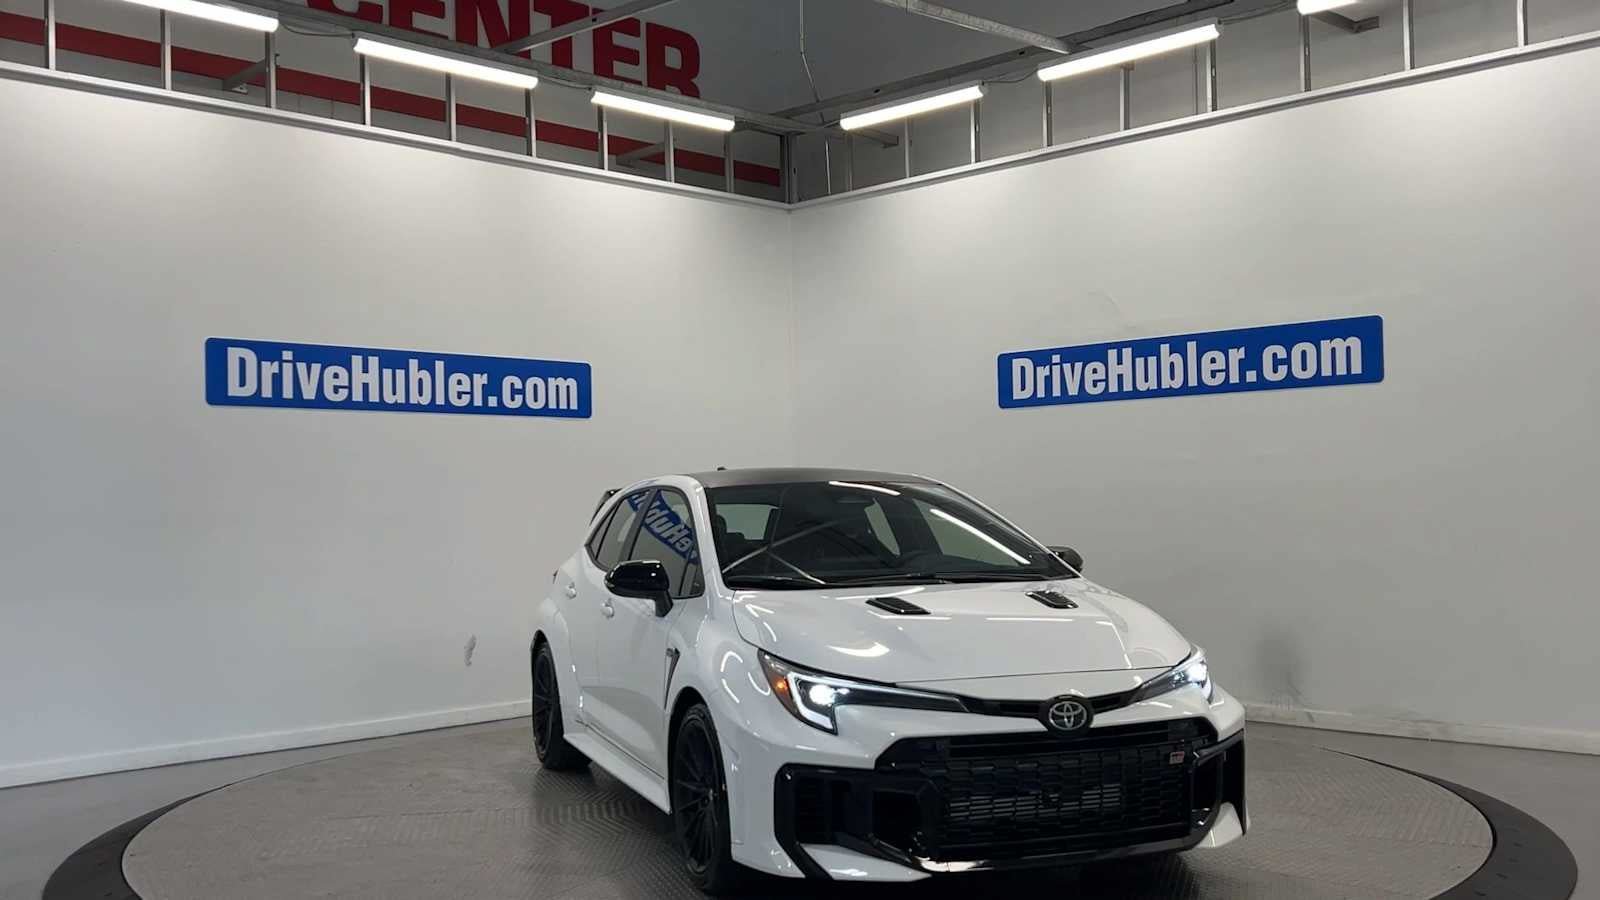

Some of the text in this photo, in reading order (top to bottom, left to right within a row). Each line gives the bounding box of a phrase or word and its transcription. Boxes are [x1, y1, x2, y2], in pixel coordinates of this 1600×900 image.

[307, 0, 702, 99] NTER
[226, 346, 579, 410] DriveHubler.com
[1011, 335, 1363, 400] DriveHubler.com
